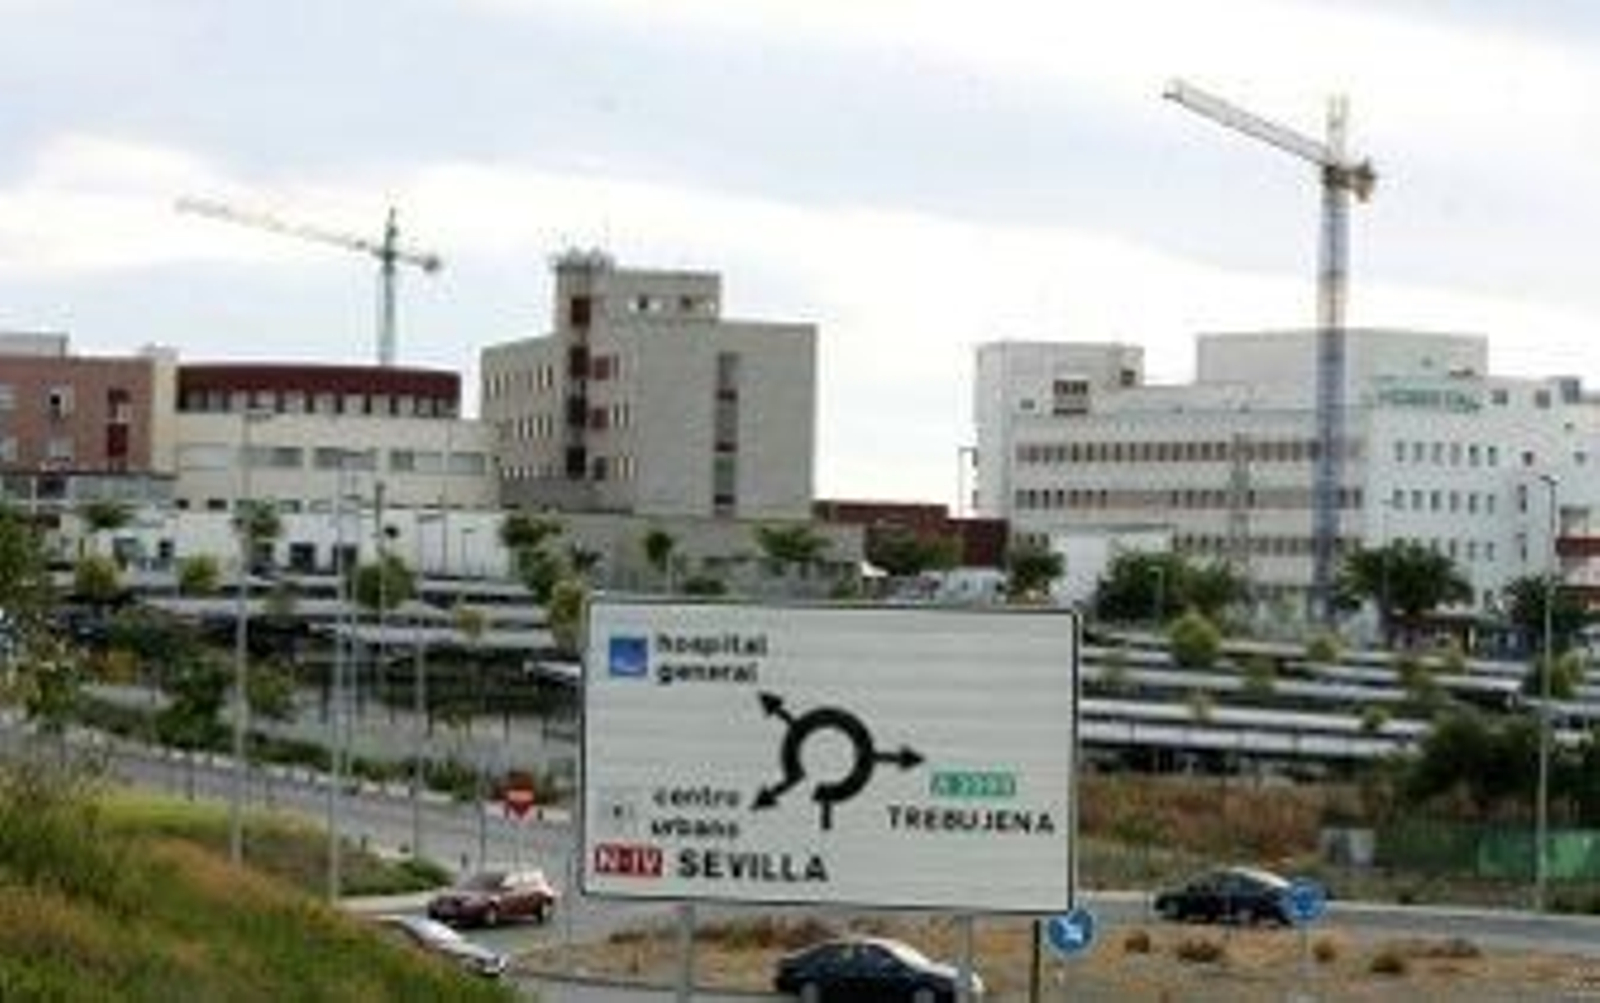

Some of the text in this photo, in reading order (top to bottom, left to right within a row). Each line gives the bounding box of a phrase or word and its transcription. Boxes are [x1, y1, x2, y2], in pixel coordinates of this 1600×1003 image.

[656, 633, 768, 657] hospital
[656, 662, 758, 685] general
[653, 786, 740, 807] centro
[887, 805, 1055, 834] TREBUJENA
[677, 849, 828, 882] SEVILLA
